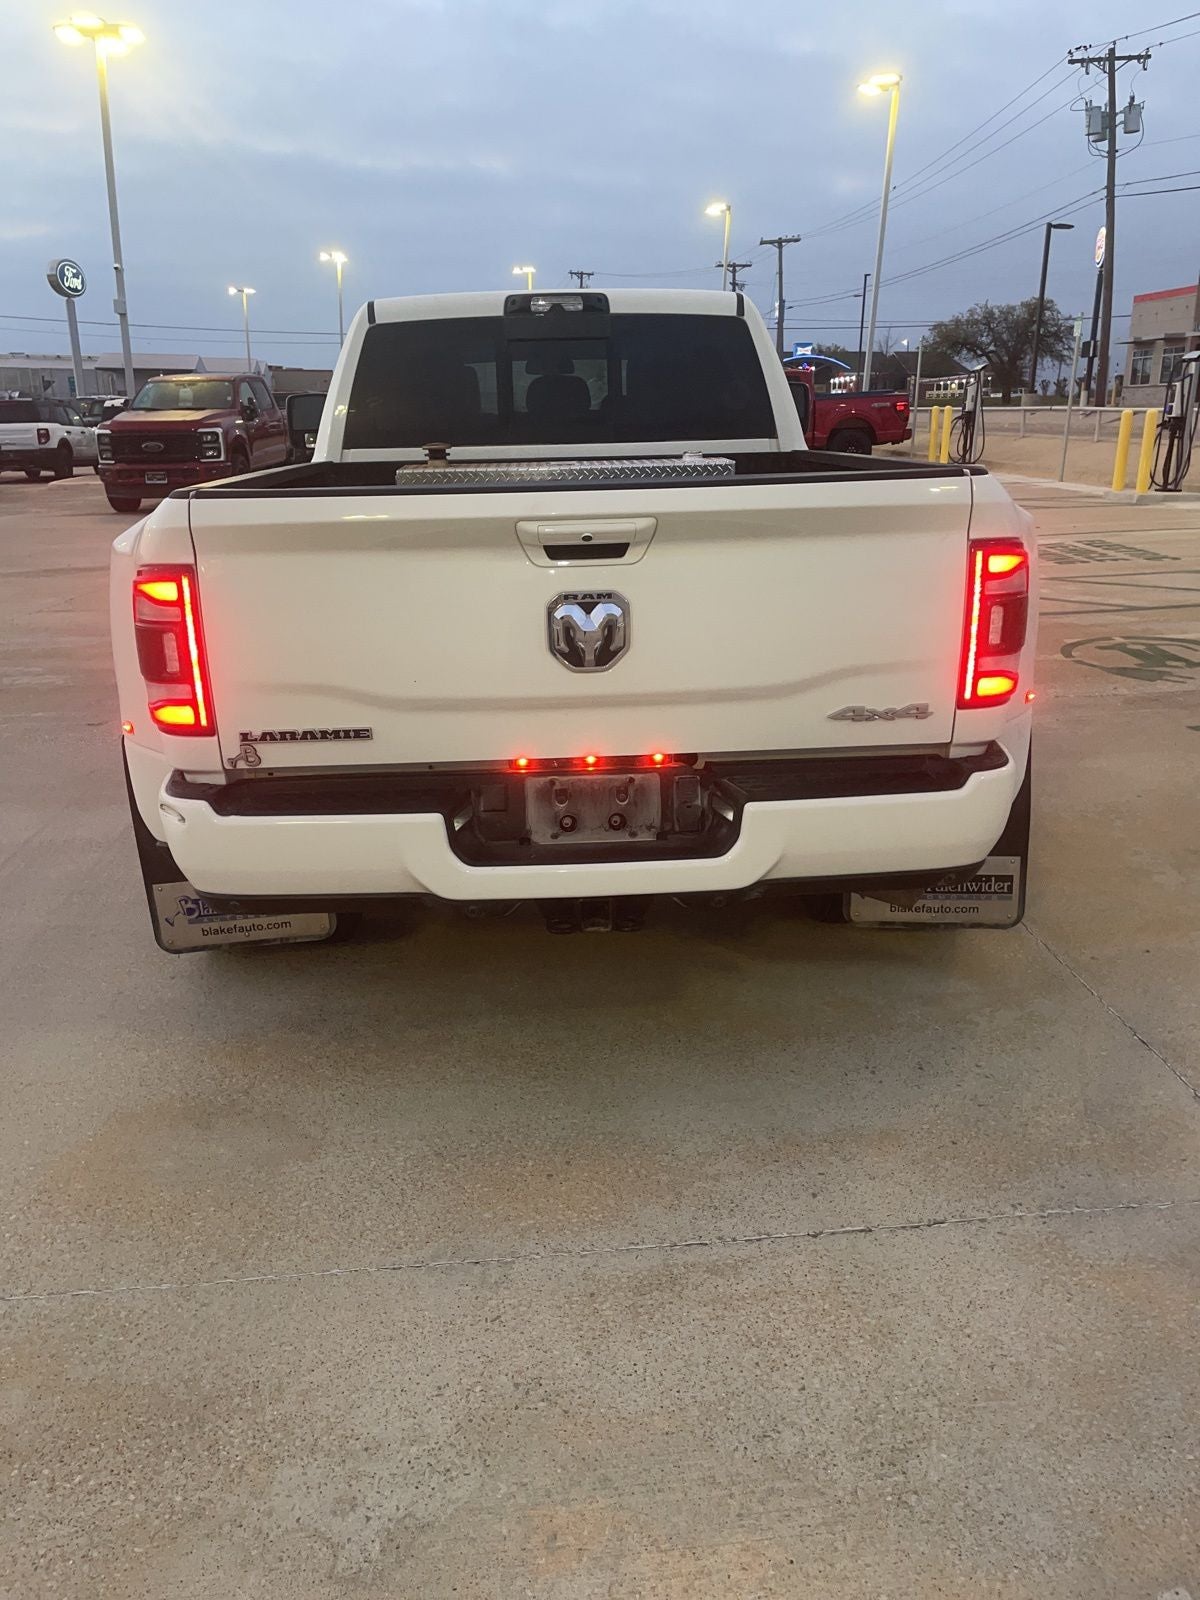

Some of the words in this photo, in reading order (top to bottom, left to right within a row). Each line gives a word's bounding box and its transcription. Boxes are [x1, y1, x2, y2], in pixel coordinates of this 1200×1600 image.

[63, 265, 82, 290] Ford
[563, 592, 613, 601] RAM
[239, 728, 372, 743] LARAMIE
[201, 919, 292, 937] blakefauto.com
